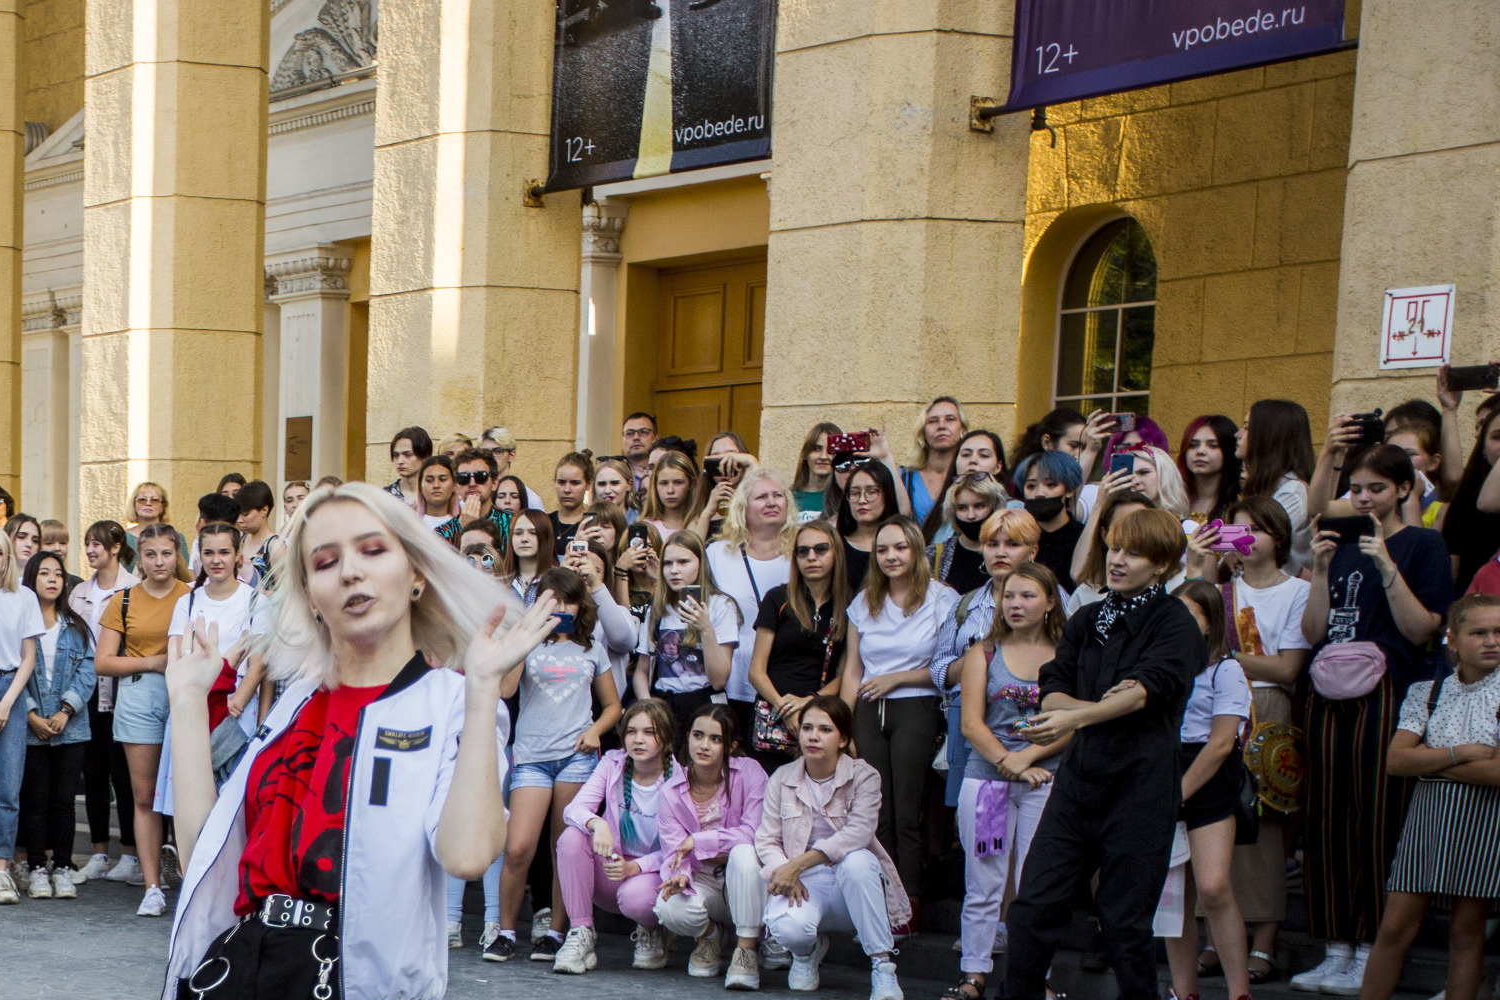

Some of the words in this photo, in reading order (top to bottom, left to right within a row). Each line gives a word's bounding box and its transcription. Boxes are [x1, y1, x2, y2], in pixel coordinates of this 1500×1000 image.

[1171, 6, 1307, 50] vpobede.ru
[1035, 42, 1079, 75] 12+
[674, 114, 765, 145] vpobede.ru
[565, 136, 597, 163] 12+
